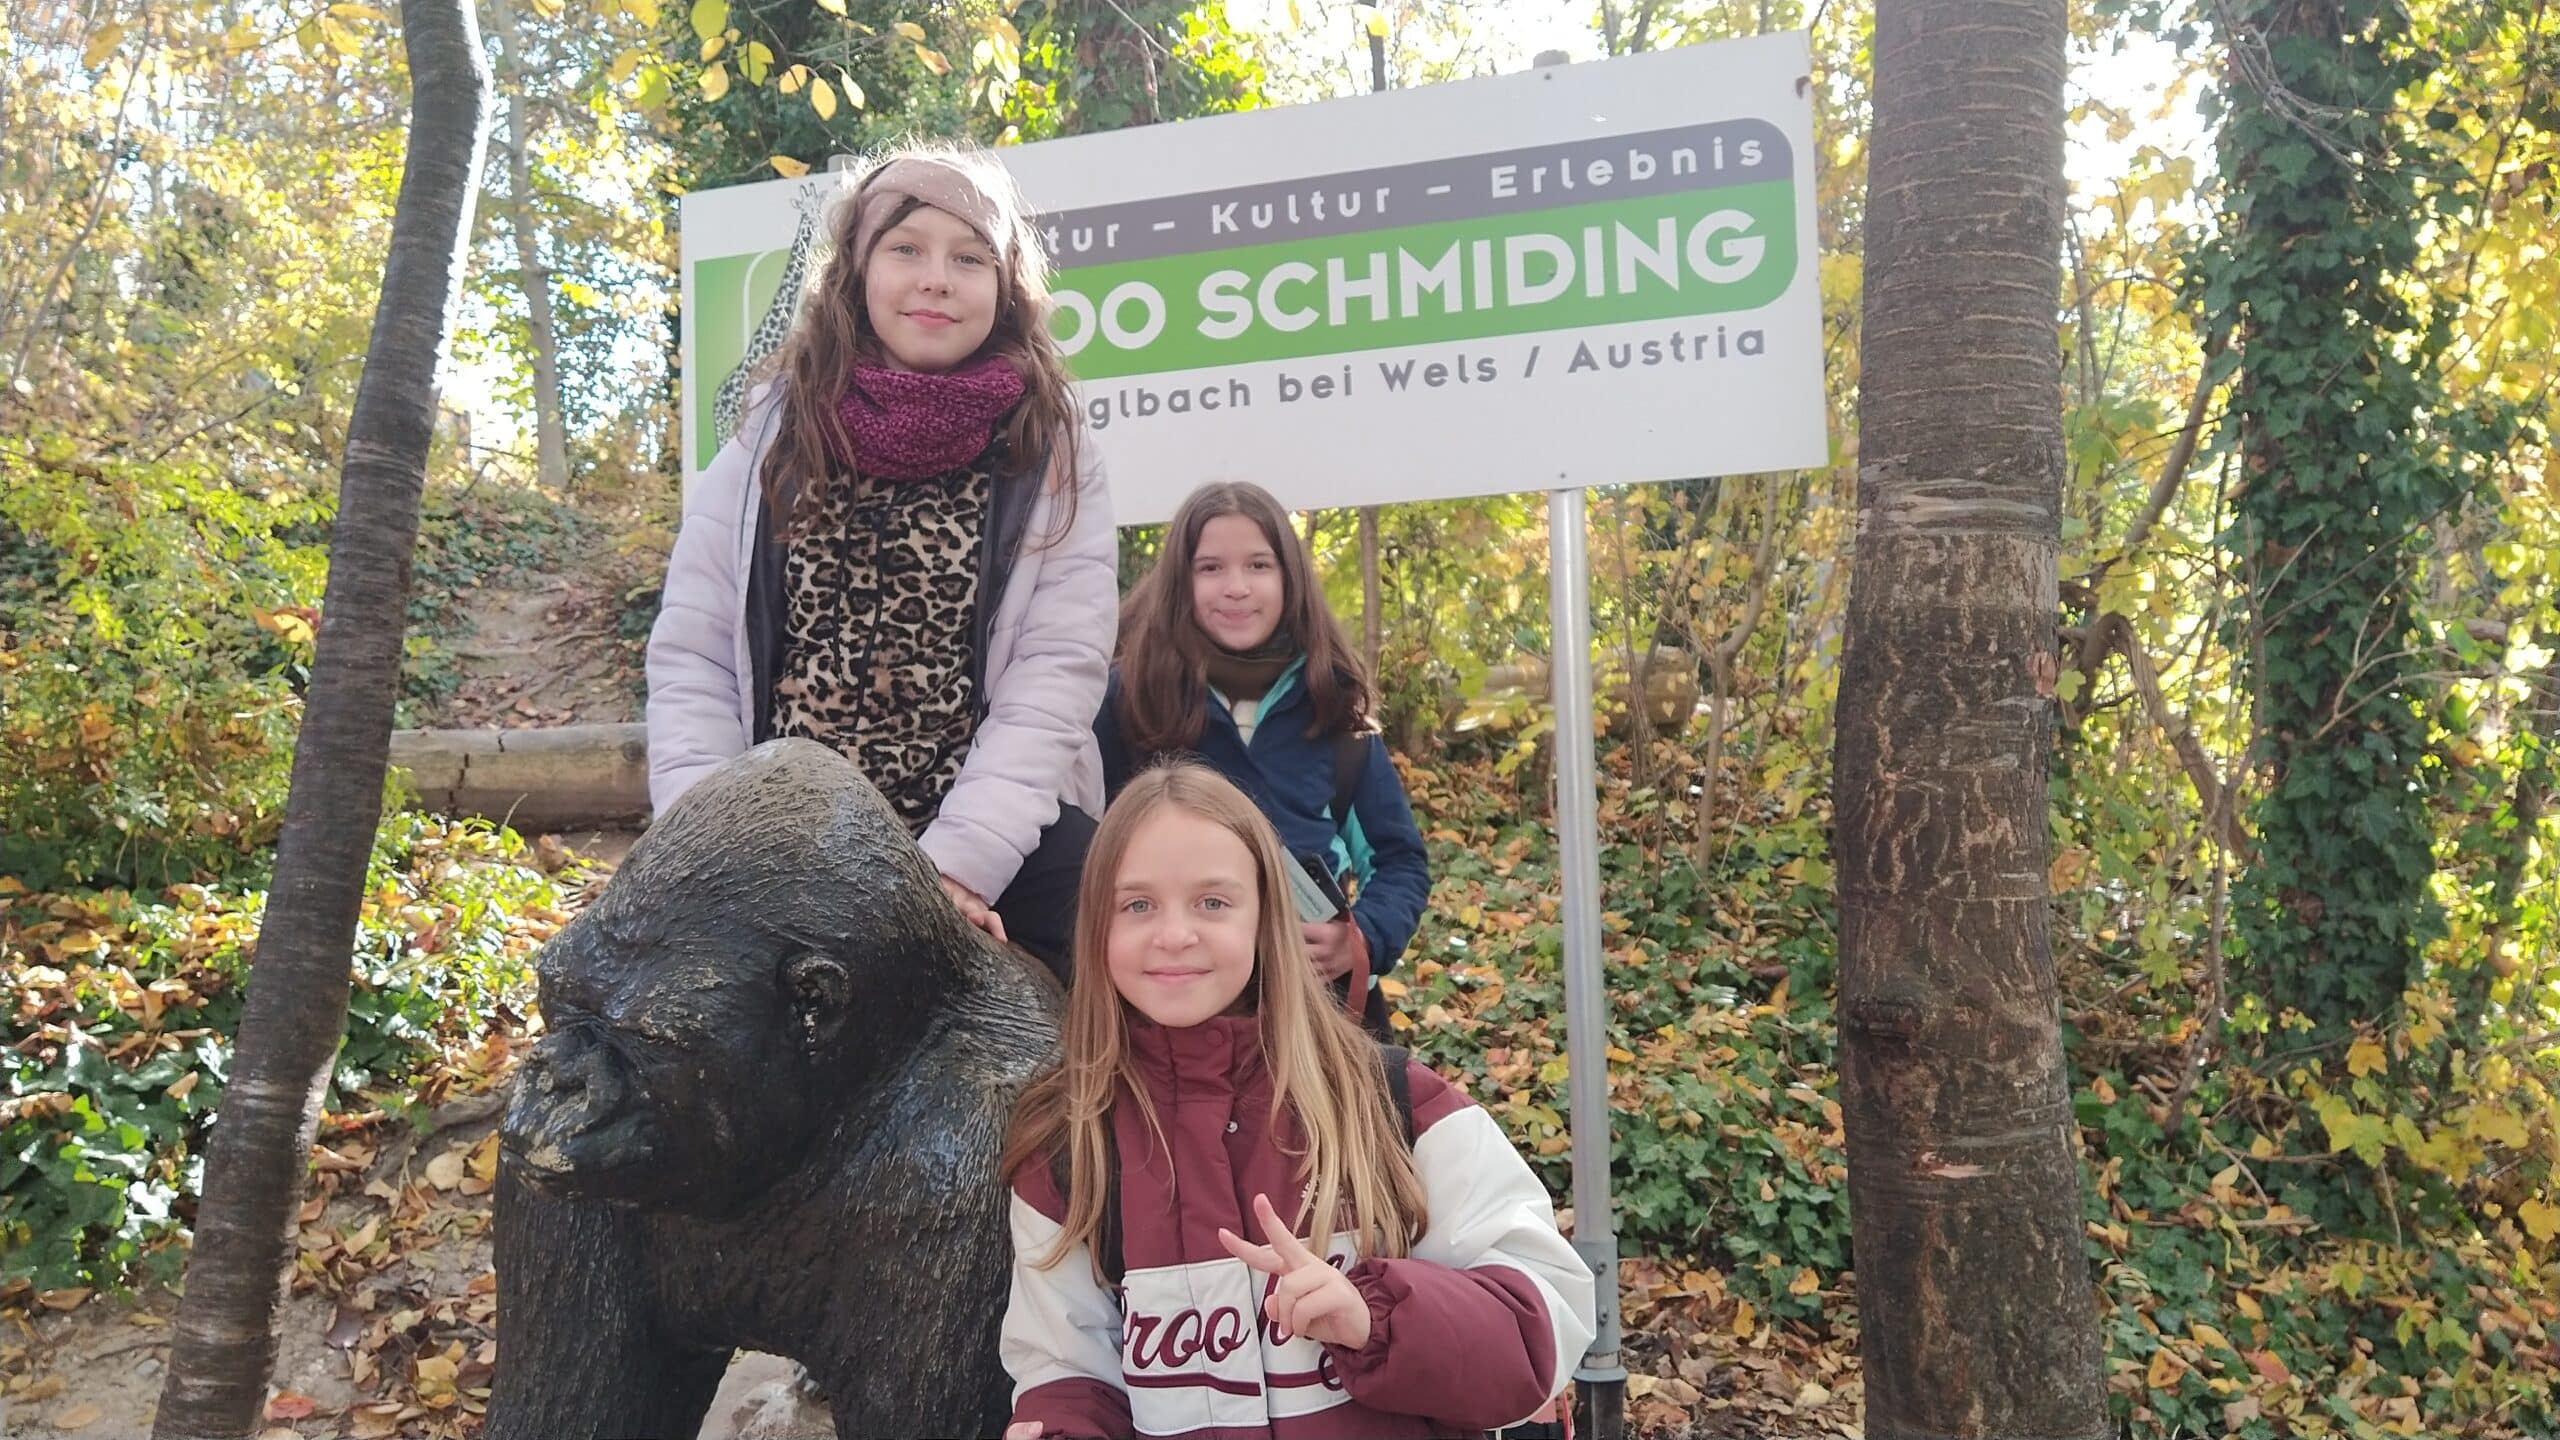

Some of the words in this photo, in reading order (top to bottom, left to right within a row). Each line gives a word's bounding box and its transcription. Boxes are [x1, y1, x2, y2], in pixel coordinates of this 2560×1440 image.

[1048, 221, 1120, 256] tur
[1211, 186, 1392, 236] Kultur
[1490, 134, 1765, 200] Erlebnis
[1045, 281, 1167, 360] OO
[1197, 207, 1767, 342] SCHMIDING
[1085, 377, 1251, 431] glbach
[1278, 364, 1354, 404] bei
[1378, 353, 1498, 394] Wels
[1566, 324, 1766, 374] Austria
